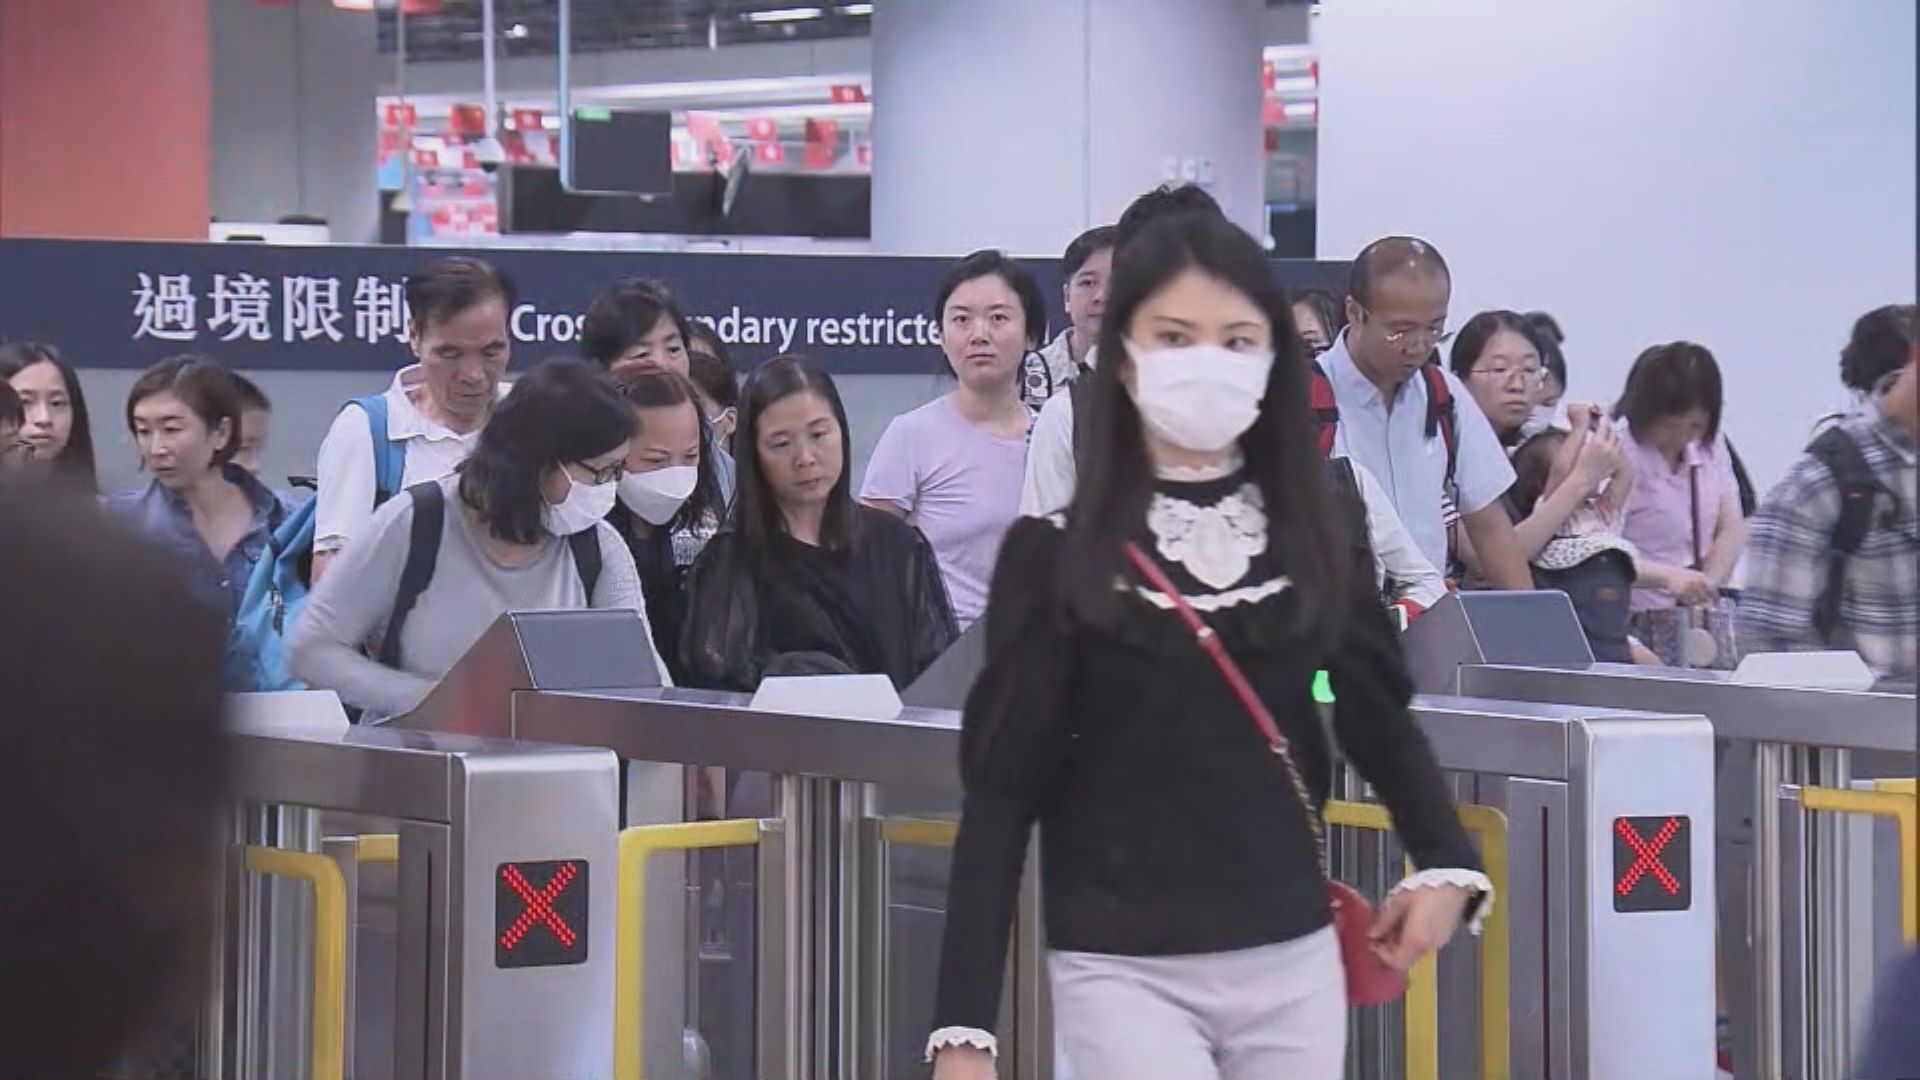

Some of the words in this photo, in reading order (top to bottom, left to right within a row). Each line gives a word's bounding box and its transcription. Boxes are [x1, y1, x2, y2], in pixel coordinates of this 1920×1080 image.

[132, 272, 412, 343] 過境限制
[510, 303, 586, 341] Cros
[684, 306, 798, 354] ndary
[806, 308, 943, 345] restricte
